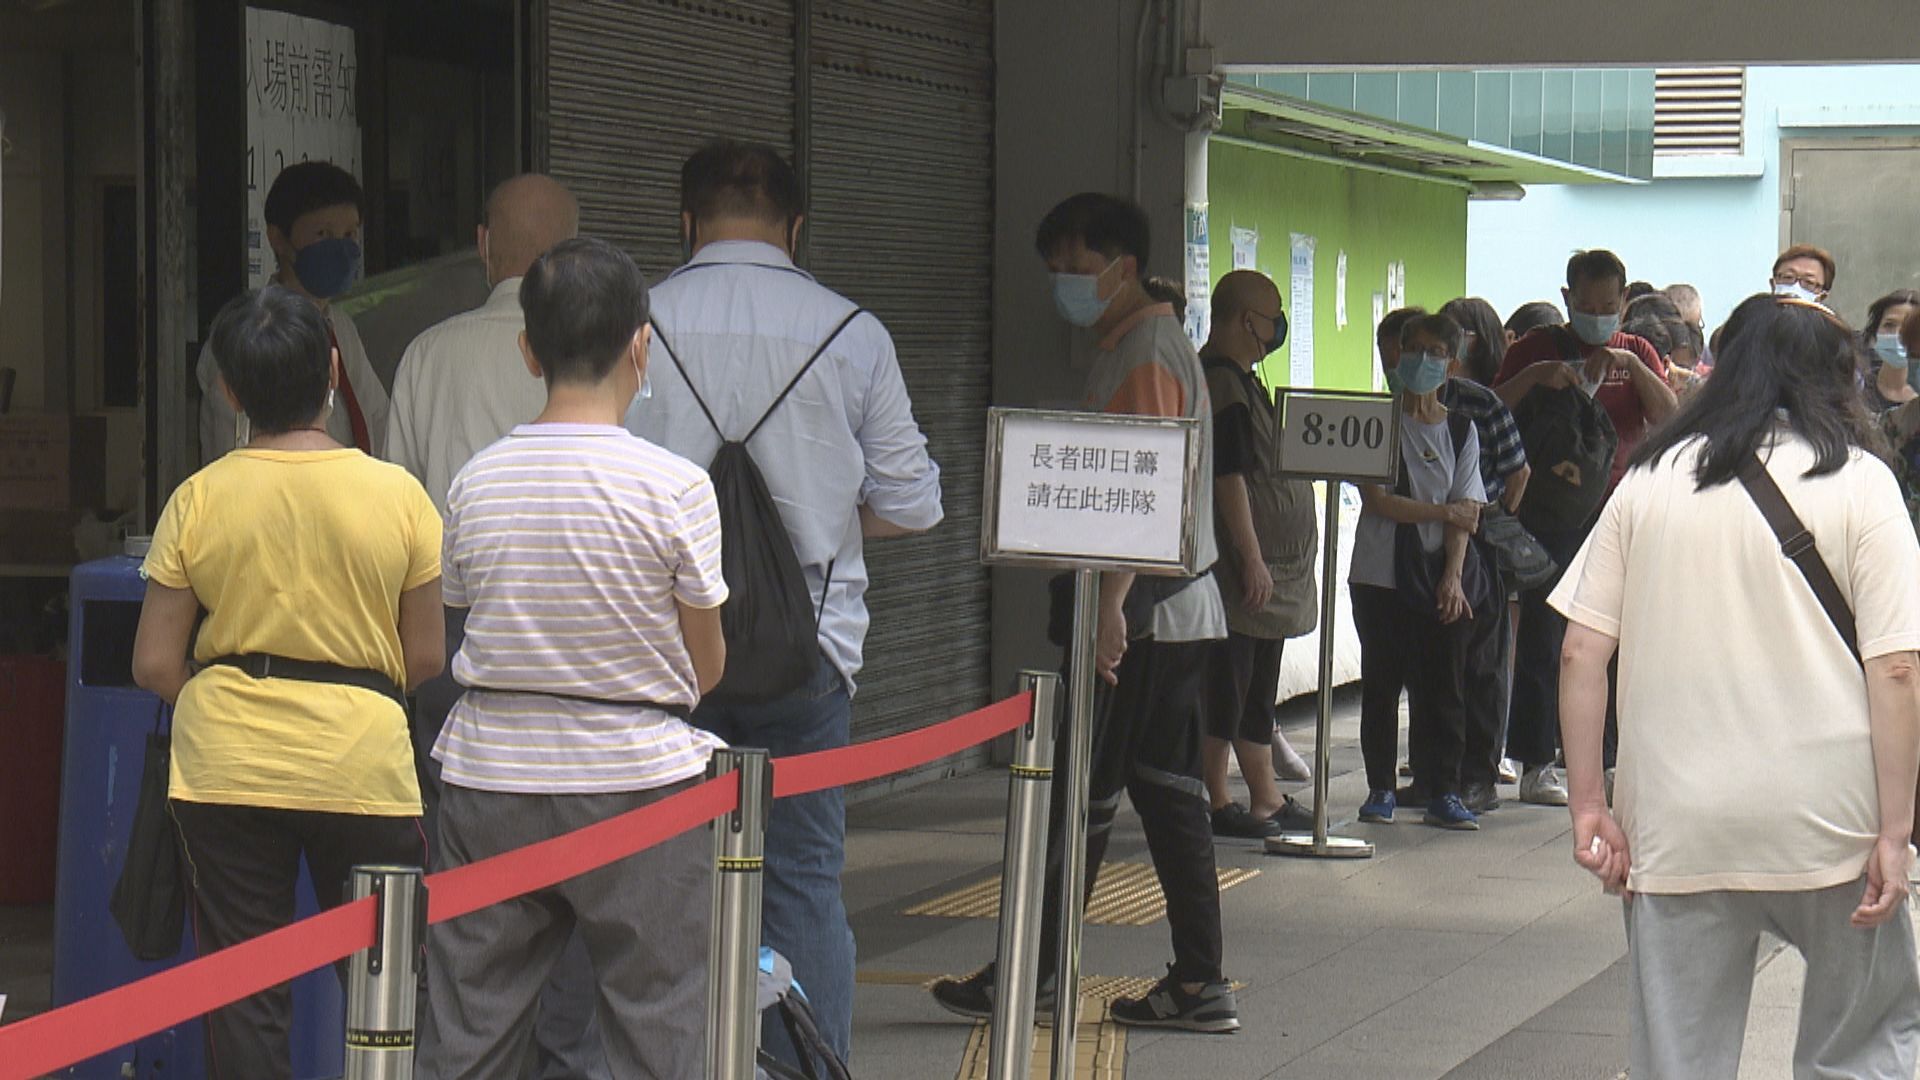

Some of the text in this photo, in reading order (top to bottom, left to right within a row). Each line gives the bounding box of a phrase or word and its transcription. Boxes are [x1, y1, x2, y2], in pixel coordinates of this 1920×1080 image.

[1302, 412, 1384, 449] 8:00
[1030, 443, 1159, 477] 長者即日籌
[1027, 481, 1156, 515] 請在此排隊
